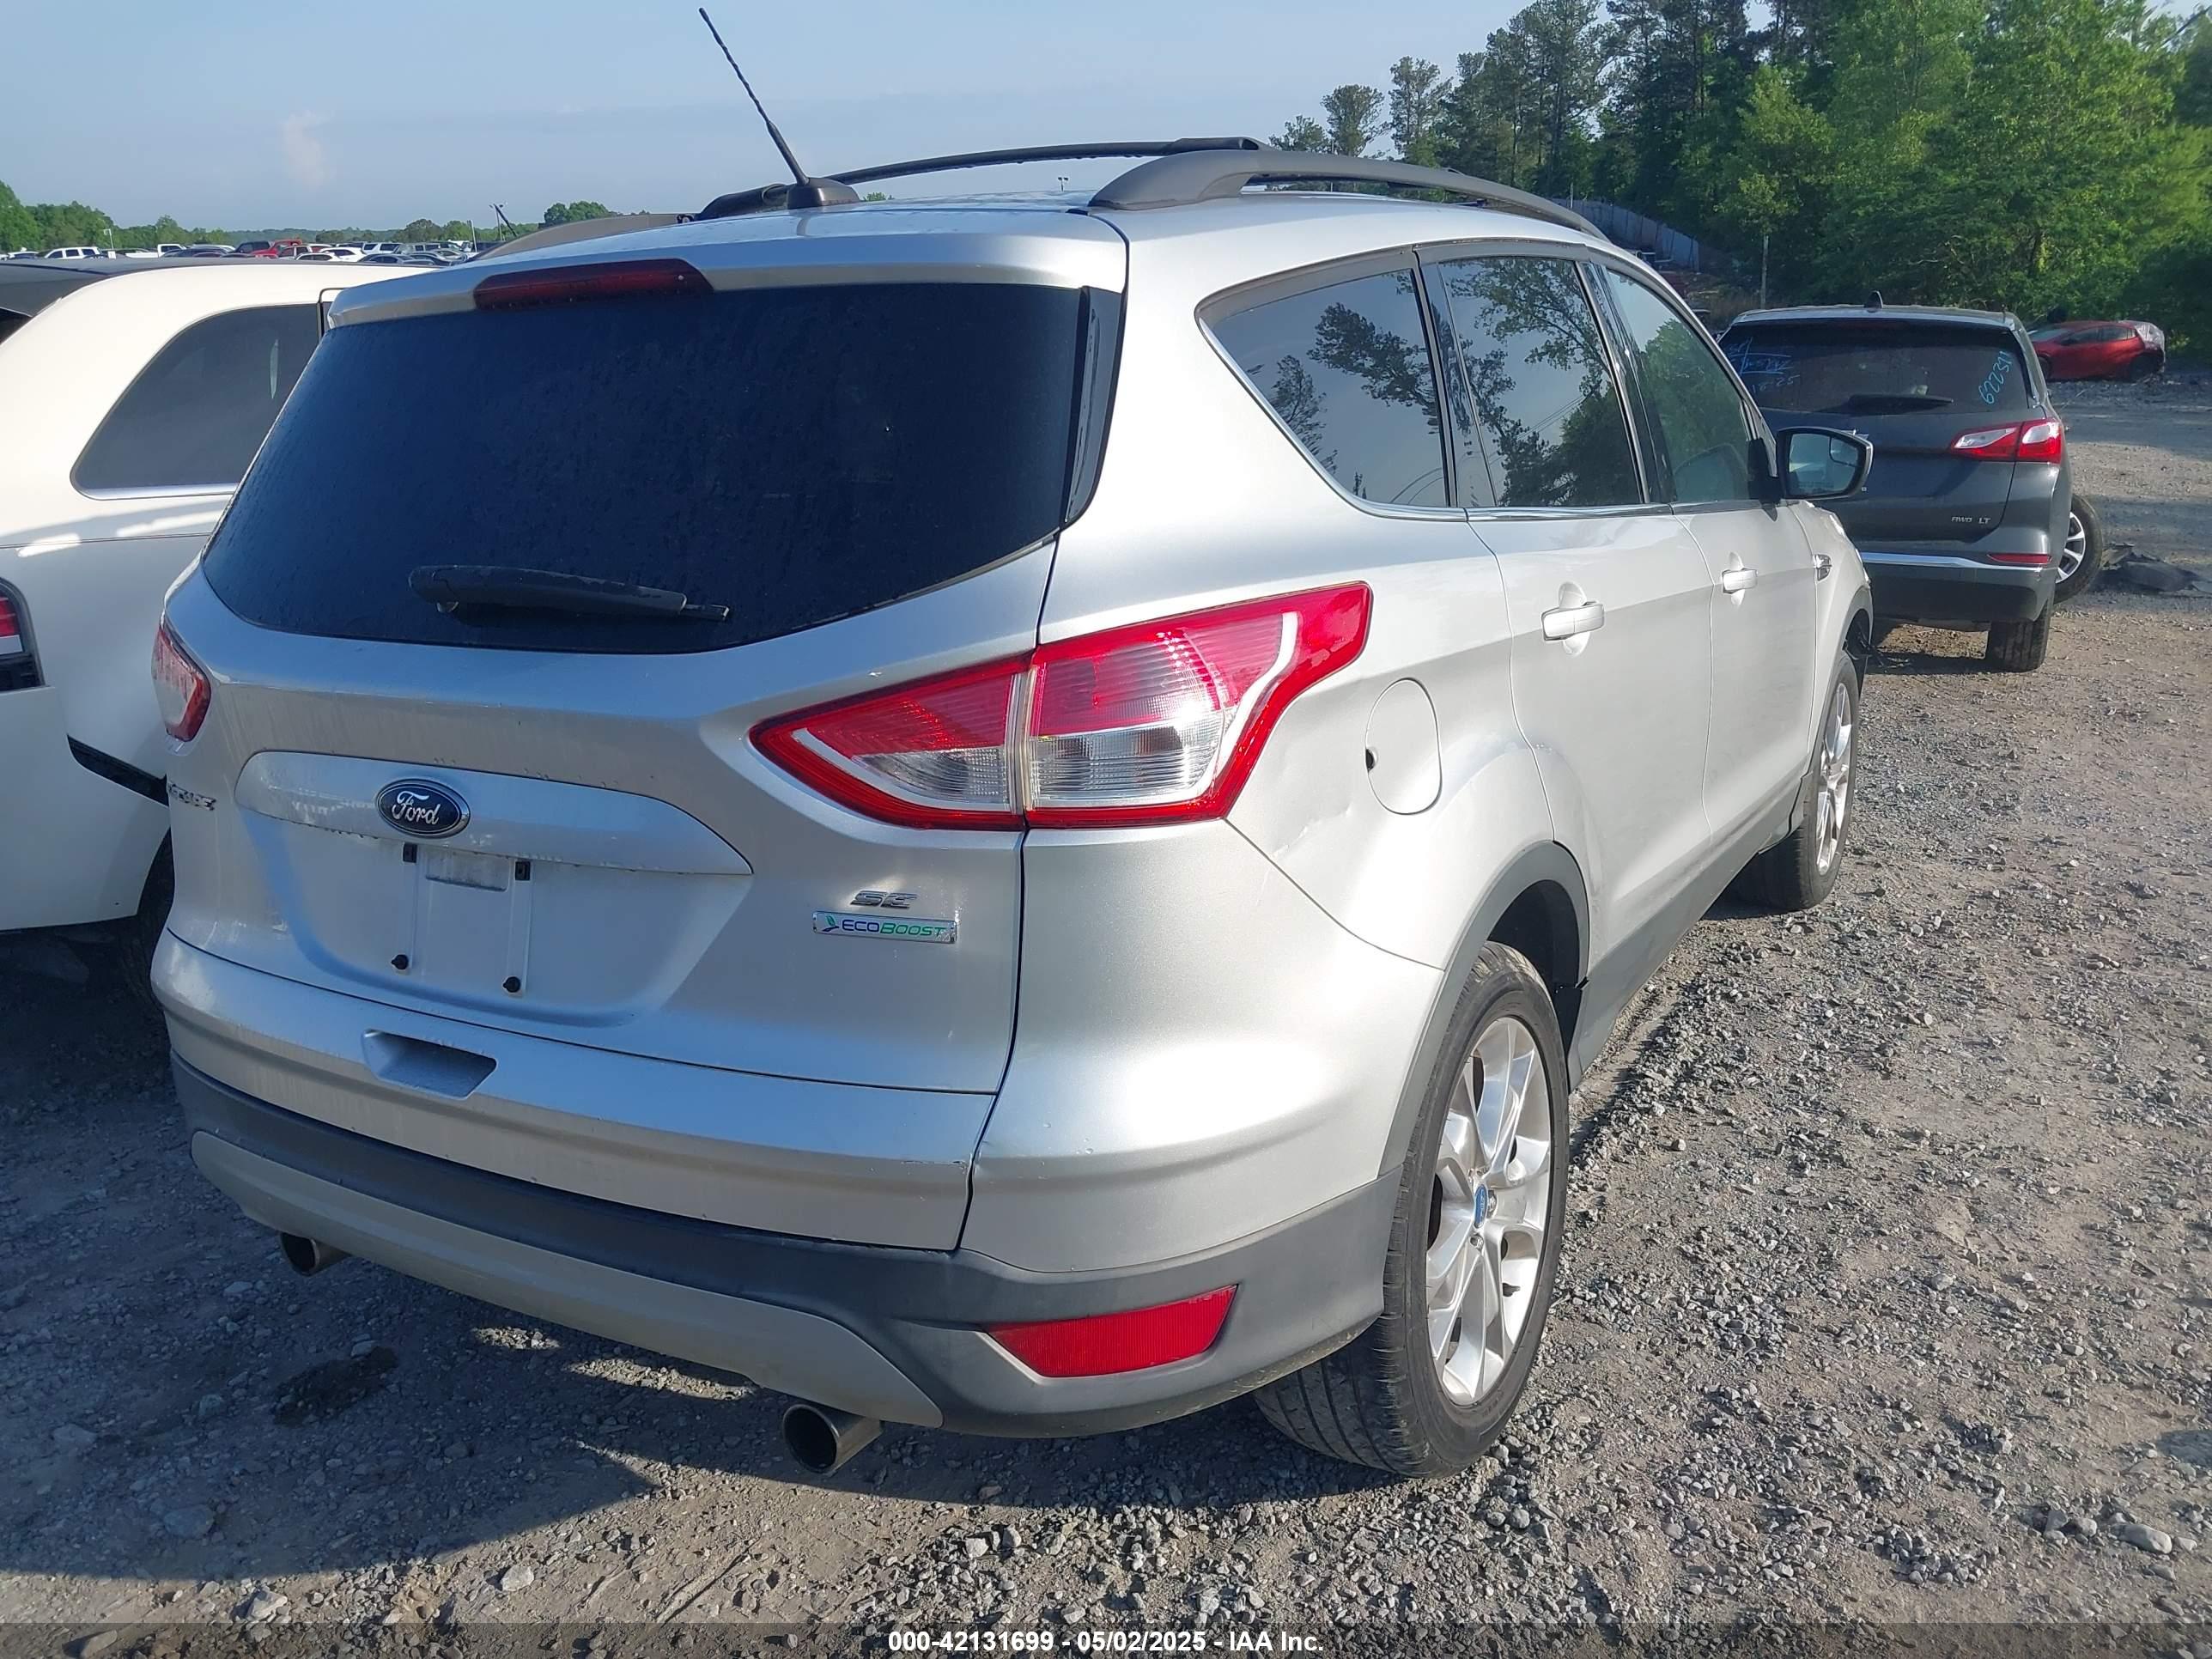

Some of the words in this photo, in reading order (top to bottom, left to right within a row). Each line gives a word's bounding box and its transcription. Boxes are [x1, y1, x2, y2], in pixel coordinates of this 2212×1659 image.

[392, 790, 441, 825] Ford
[850, 890, 918, 909] SE
[842, 919, 946, 936] ECOBOOST
